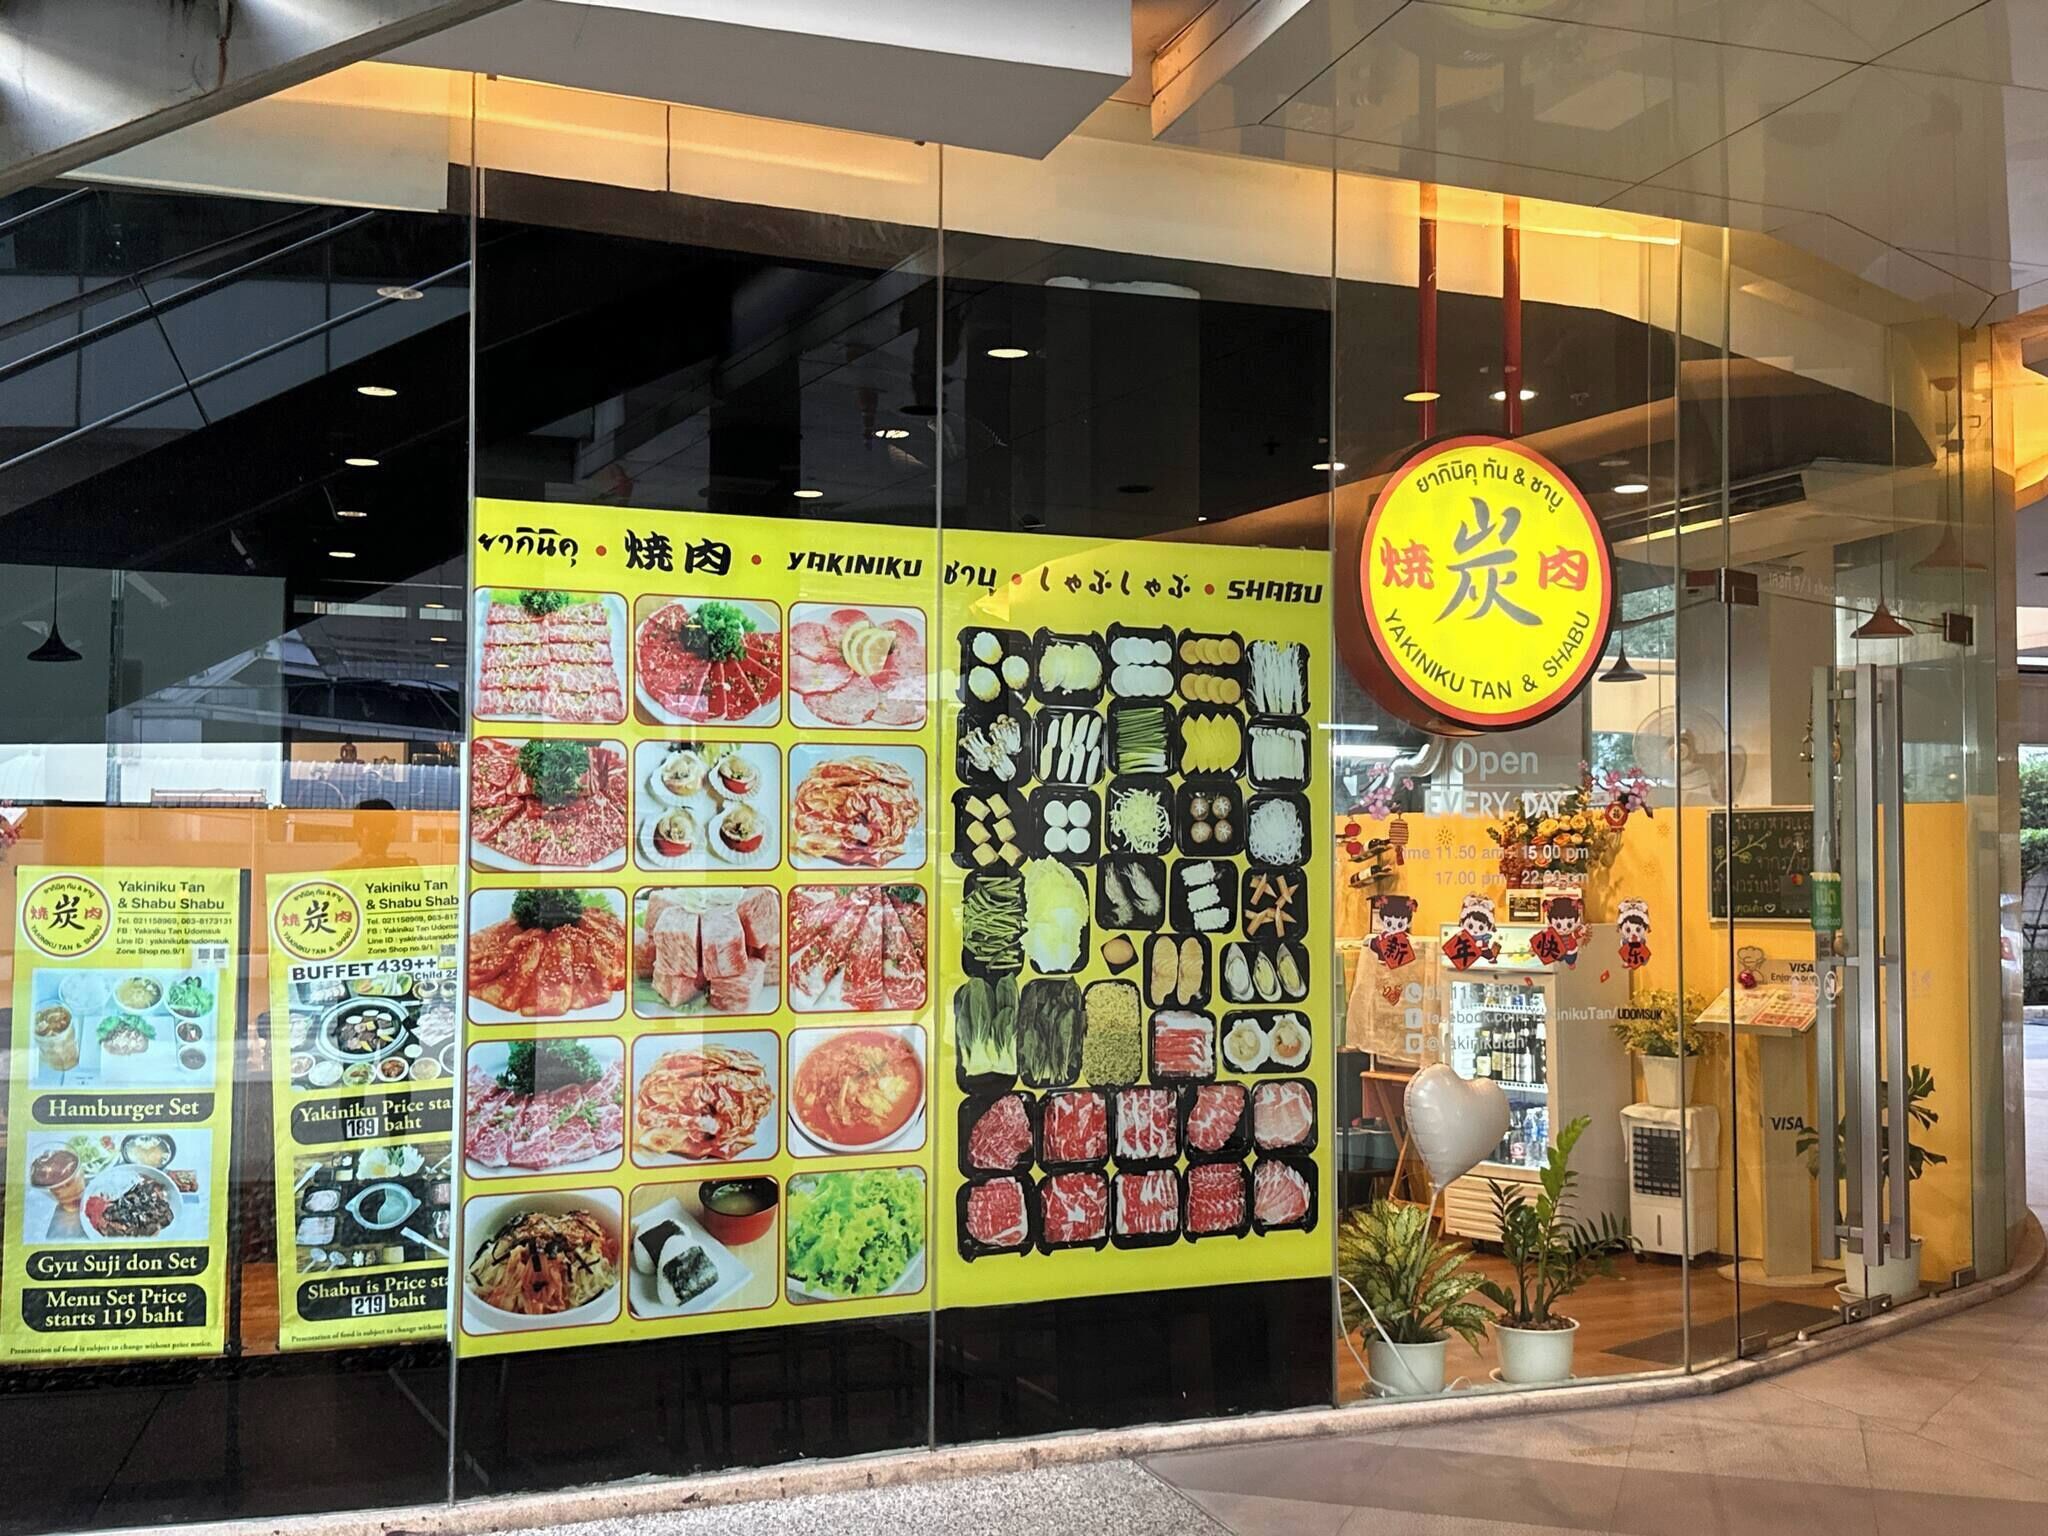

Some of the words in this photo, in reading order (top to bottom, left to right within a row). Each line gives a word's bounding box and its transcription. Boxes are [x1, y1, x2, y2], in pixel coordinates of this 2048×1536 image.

[1416, 460, 1478, 493] ยากินิคุ
[1483, 457, 1508, 480] ทัน
[1513, 467, 1525, 487] &
[1530, 476, 1564, 513] ชาบู
[787, 551, 923, 578] YAKINIKU
[1433, 496, 1543, 626] 炭
[1538, 544, 1590, 592] 肉
[1227, 579, 1323, 604] SHABU
[1384, 608, 1465, 693] YAKINIKU
[1470, 679, 1513, 700] TAN
[1522, 673, 1539, 693] &
[1543, 610, 1591, 678] SHABU
[1452, 741, 1539, 782] Open
[1424, 788, 1510, 818] EVERY
[1521, 790, 1563, 818] DAY
[1436, 845, 1476, 860] 11.50
[118, 880, 176, 893] Yakiniku
[180, 881, 205, 893] Tan
[364, 881, 420, 895] Yakiniku
[424, 880, 448, 891] Tan
[1436, 871, 1476, 885] 17.00
[47, 893, 86, 930] 炭
[117, 897, 128, 909] &
[131, 897, 176, 909] Shabu
[180, 898, 225, 910] Shabu
[366, 899, 376, 910] &
[379, 896, 422, 909] Shabu
[300, 899, 337, 936] 炭
[116, 937, 133, 945] Line
[135, 937, 144, 945] ID
[367, 937, 383, 945] Line
[383, 926, 414, 935] Yakiniku
[116, 947, 136, 955] Zone
[138, 947, 159, 956] Shop
[367, 947, 387, 955] Zone
[1450, 938, 1477, 966] 年
[292, 962, 374, 981] BUFFET
[377, 957, 437, 973] 439++
[414, 970, 442, 980] Child
[1789, 962, 1815, 973] VISA
[49, 1097, 164, 1122] Hamburger
[169, 1097, 200, 1116] Set
[300, 1103, 377, 1123] Yakiniku
[382, 1098, 425, 1116] Price
[428, 1098, 452, 1111] sta
[347, 1119, 376, 1138] 189
[384, 1114, 422, 1132] baht
[1770, 1116, 1804, 1131] VISA
[38, 1256, 78, 1278] Gyu
[83, 1254, 121, 1277] Suji
[126, 1253, 163, 1271] don
[168, 1252, 198, 1270] Set
[46, 1290, 101, 1308] Menu
[106, 1290, 136, 1307] Set
[141, 1287, 187, 1305] Price
[307, 1283, 361, 1300] Shabu
[366, 1280, 380, 1294] is
[385, 1276, 427, 1293] Price
[354, 1296, 383, 1315] 219
[388, 1292, 426, 1309] baht
[45, 1311, 96, 1327] starts
[103, 1308, 137, 1326] 119
[142, 1306, 184, 1324] baht
